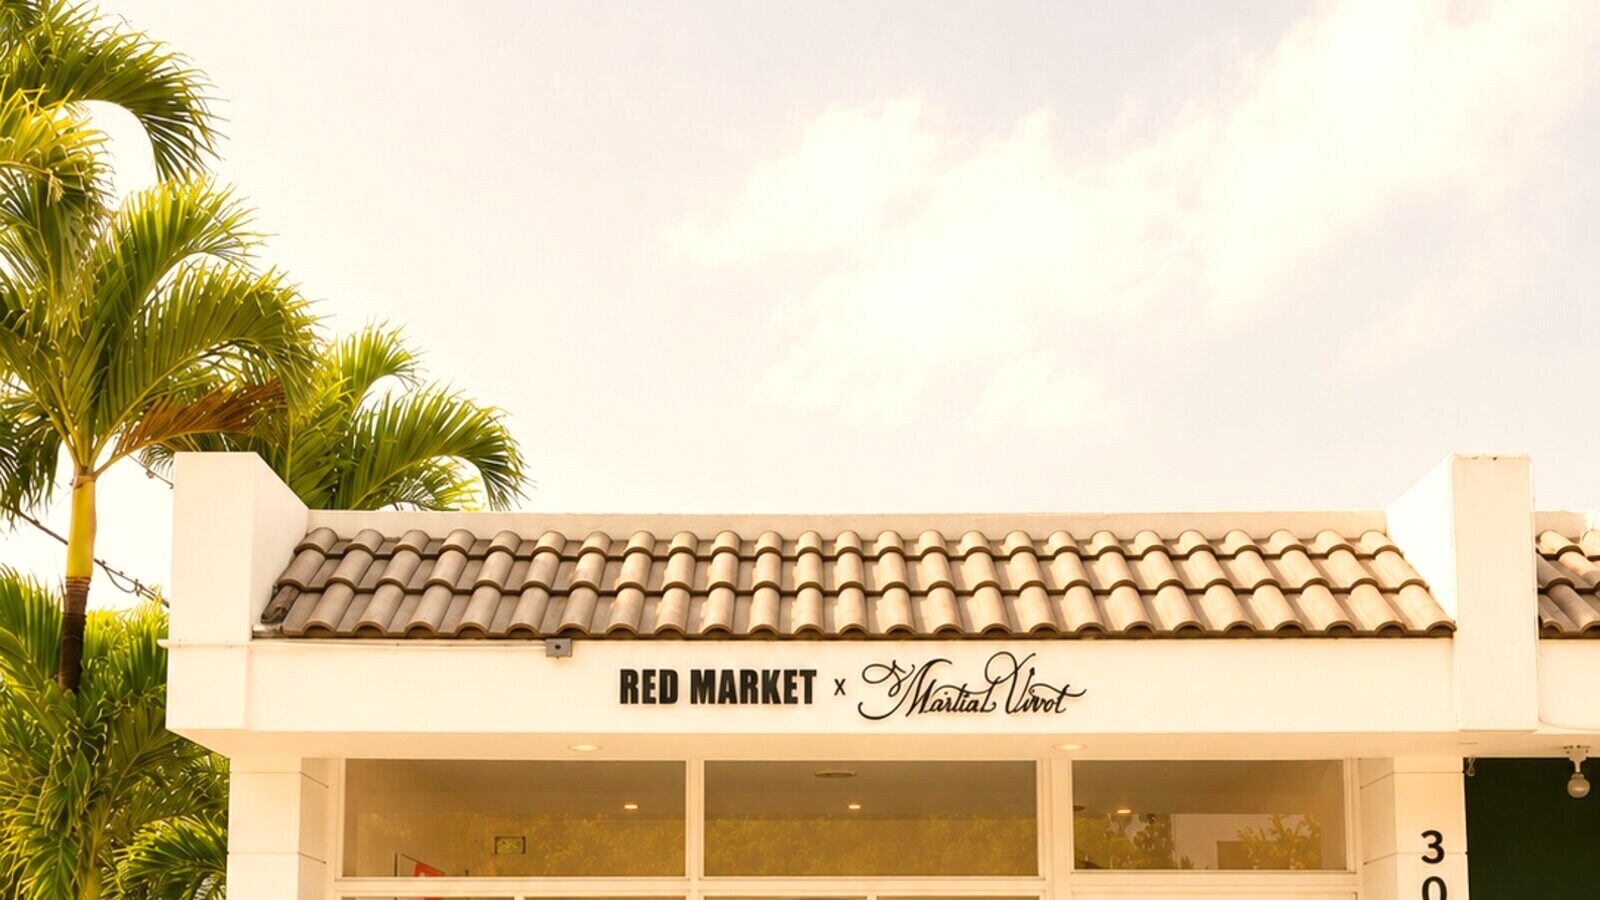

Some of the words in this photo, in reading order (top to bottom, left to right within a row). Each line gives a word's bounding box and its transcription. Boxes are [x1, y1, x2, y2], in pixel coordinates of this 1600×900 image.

[619, 669, 679, 705] RED
[690, 669, 817, 705] MARKET
[857, 658, 1001, 720] Martial
[984, 651, 1087, 714] Vivot
